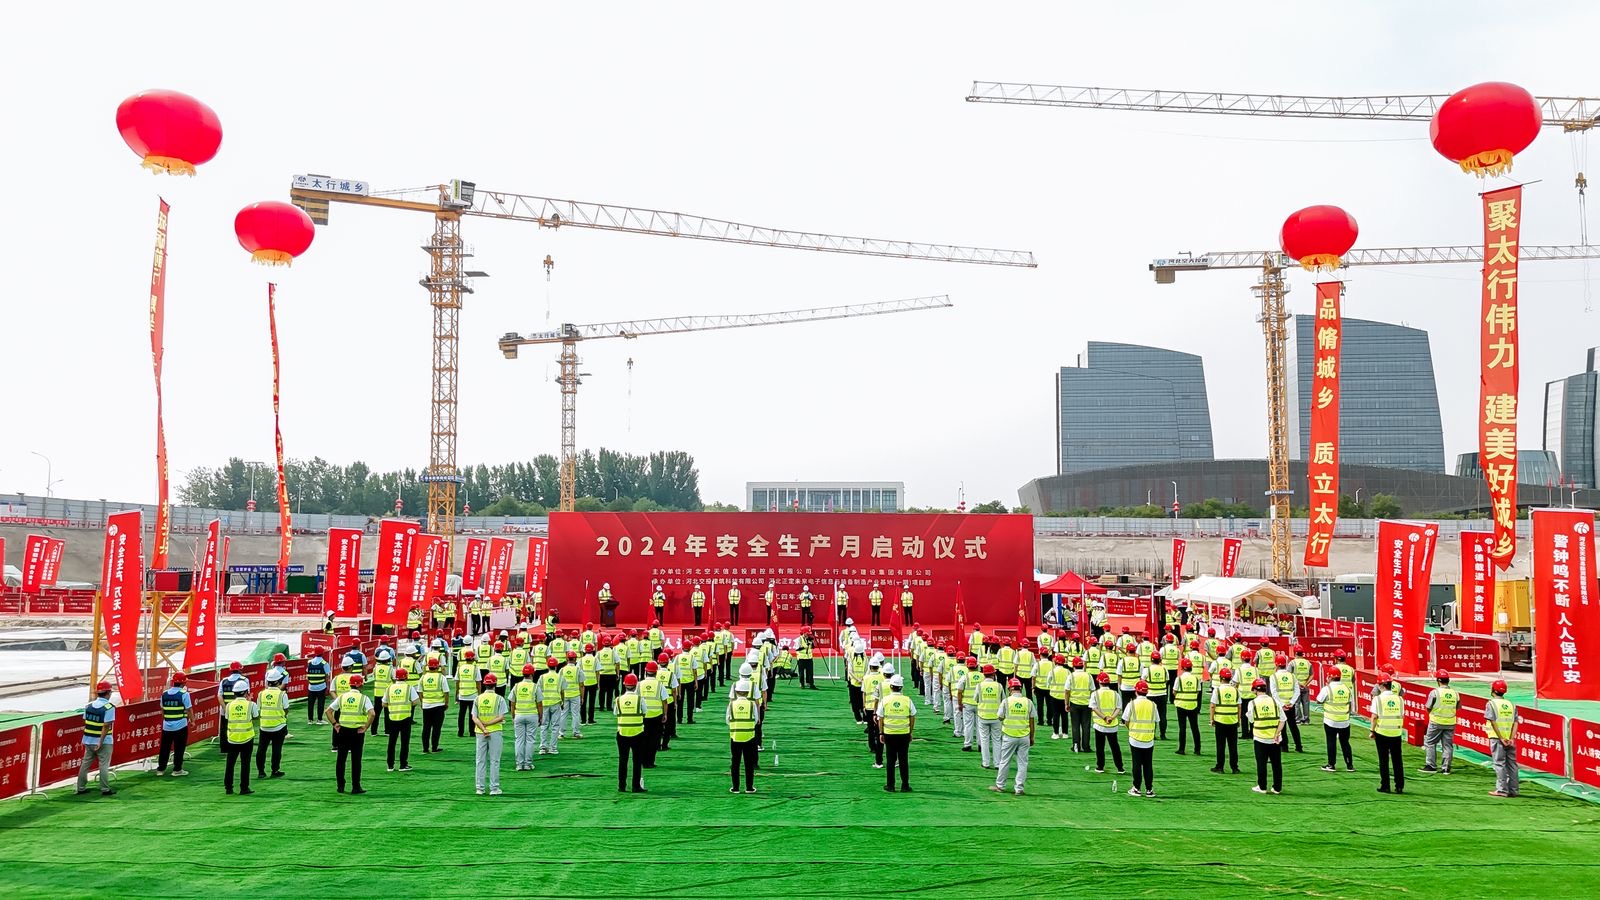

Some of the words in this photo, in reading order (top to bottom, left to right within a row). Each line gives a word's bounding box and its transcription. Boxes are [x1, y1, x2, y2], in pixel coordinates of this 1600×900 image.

[312, 178, 363, 192] 太行城乡
[1485, 200, 1518, 370] 聚太行伟力
[1484, 393, 1517, 557] 建美好城乡
[1309, 441, 1335, 555] 质立太行
[340, 539, 348, 562] 安全生产
[391, 533, 404, 572] 聚太行伟力
[595, 534, 988, 560] 2024年安全生产月启动仪式
[1392, 539, 1403, 577] 安全生产
[1553, 533, 1570, 608] 警钟鸣不断
[337, 589, 345, 612] 一失万无
[386, 574, 399, 614] 建美好城乡
[1393, 580, 1403, 619] 万无一失
[1390, 623, 1403, 660] 一失万无
[1440, 653, 1494, 661] 2024年安全生产月
[1558, 612, 1581, 684] 人人保平安
[116, 724, 162, 742] 2024年安全生
[1521, 747, 1548, 763] 启动仪式
